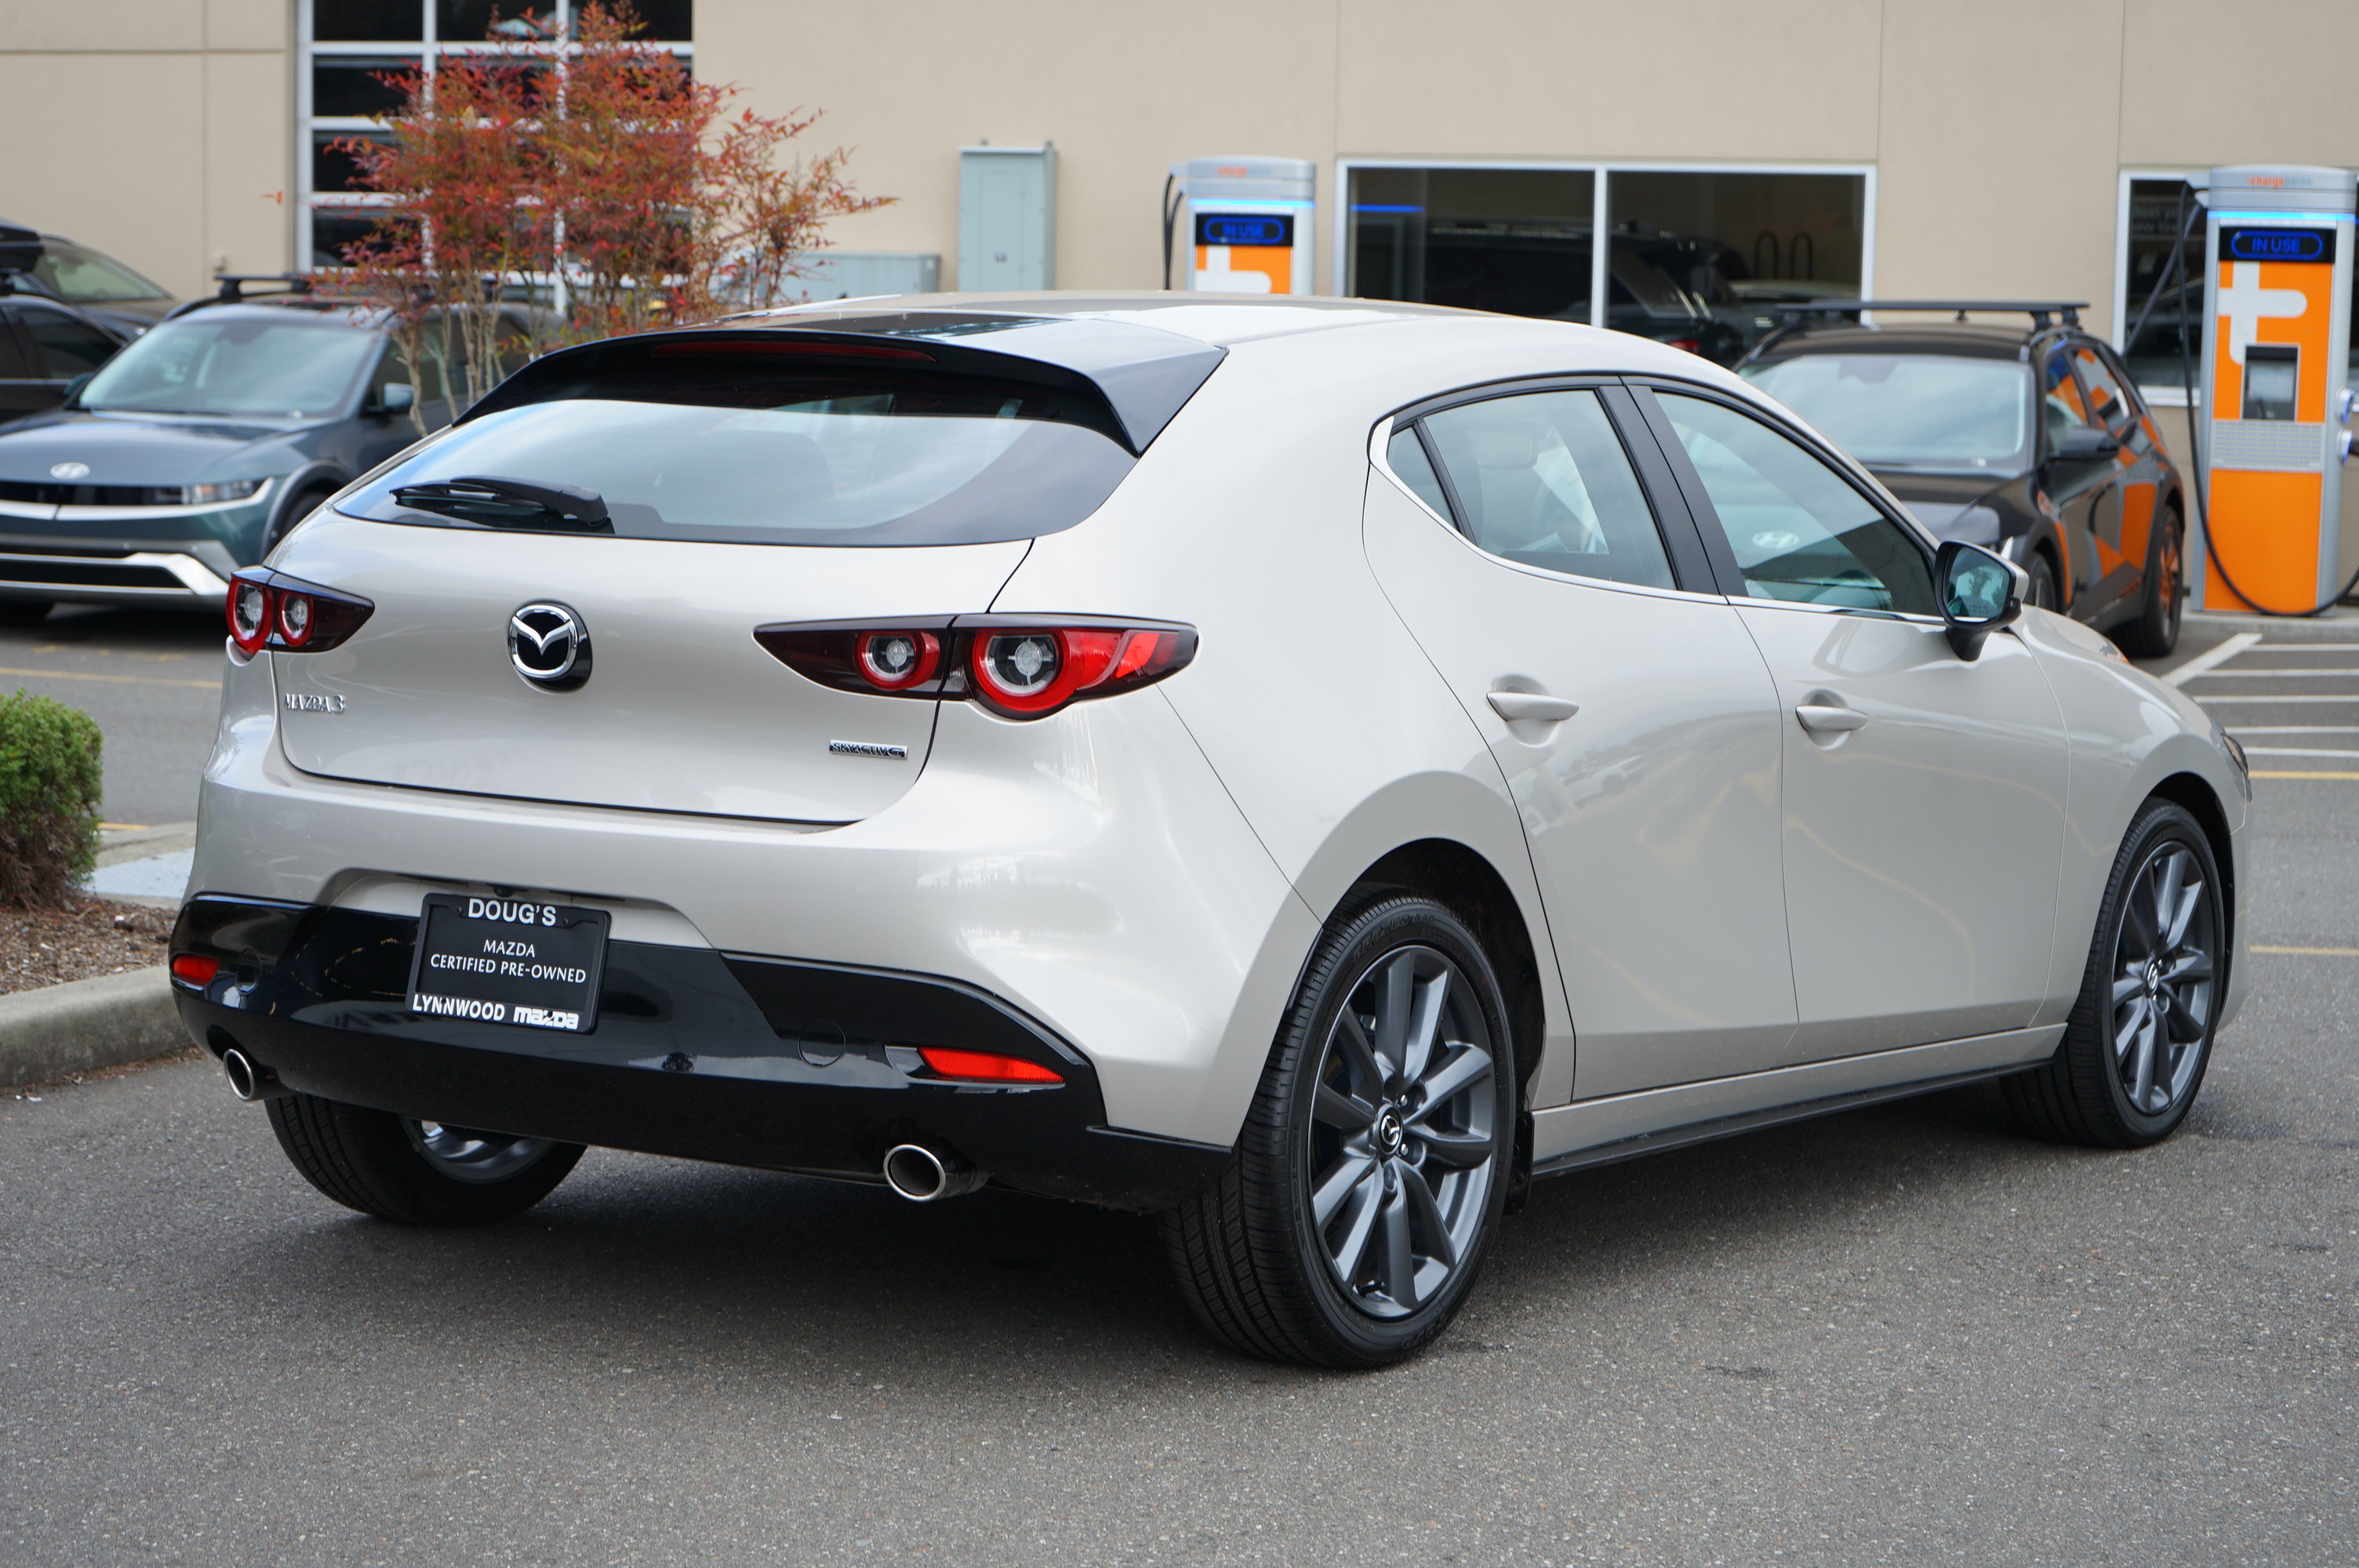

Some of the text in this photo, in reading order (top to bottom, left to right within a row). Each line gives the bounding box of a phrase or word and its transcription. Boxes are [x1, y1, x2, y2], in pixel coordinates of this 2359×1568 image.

[2252, 237, 2300, 254] IN USE
[467, 898, 556, 927] DOUG'S
[483, 938, 535, 958] MAZDA
[430, 953, 586, 984] CERTIFIED PRE-OWNED
[412, 993, 505, 1022] LYNNWOOD
